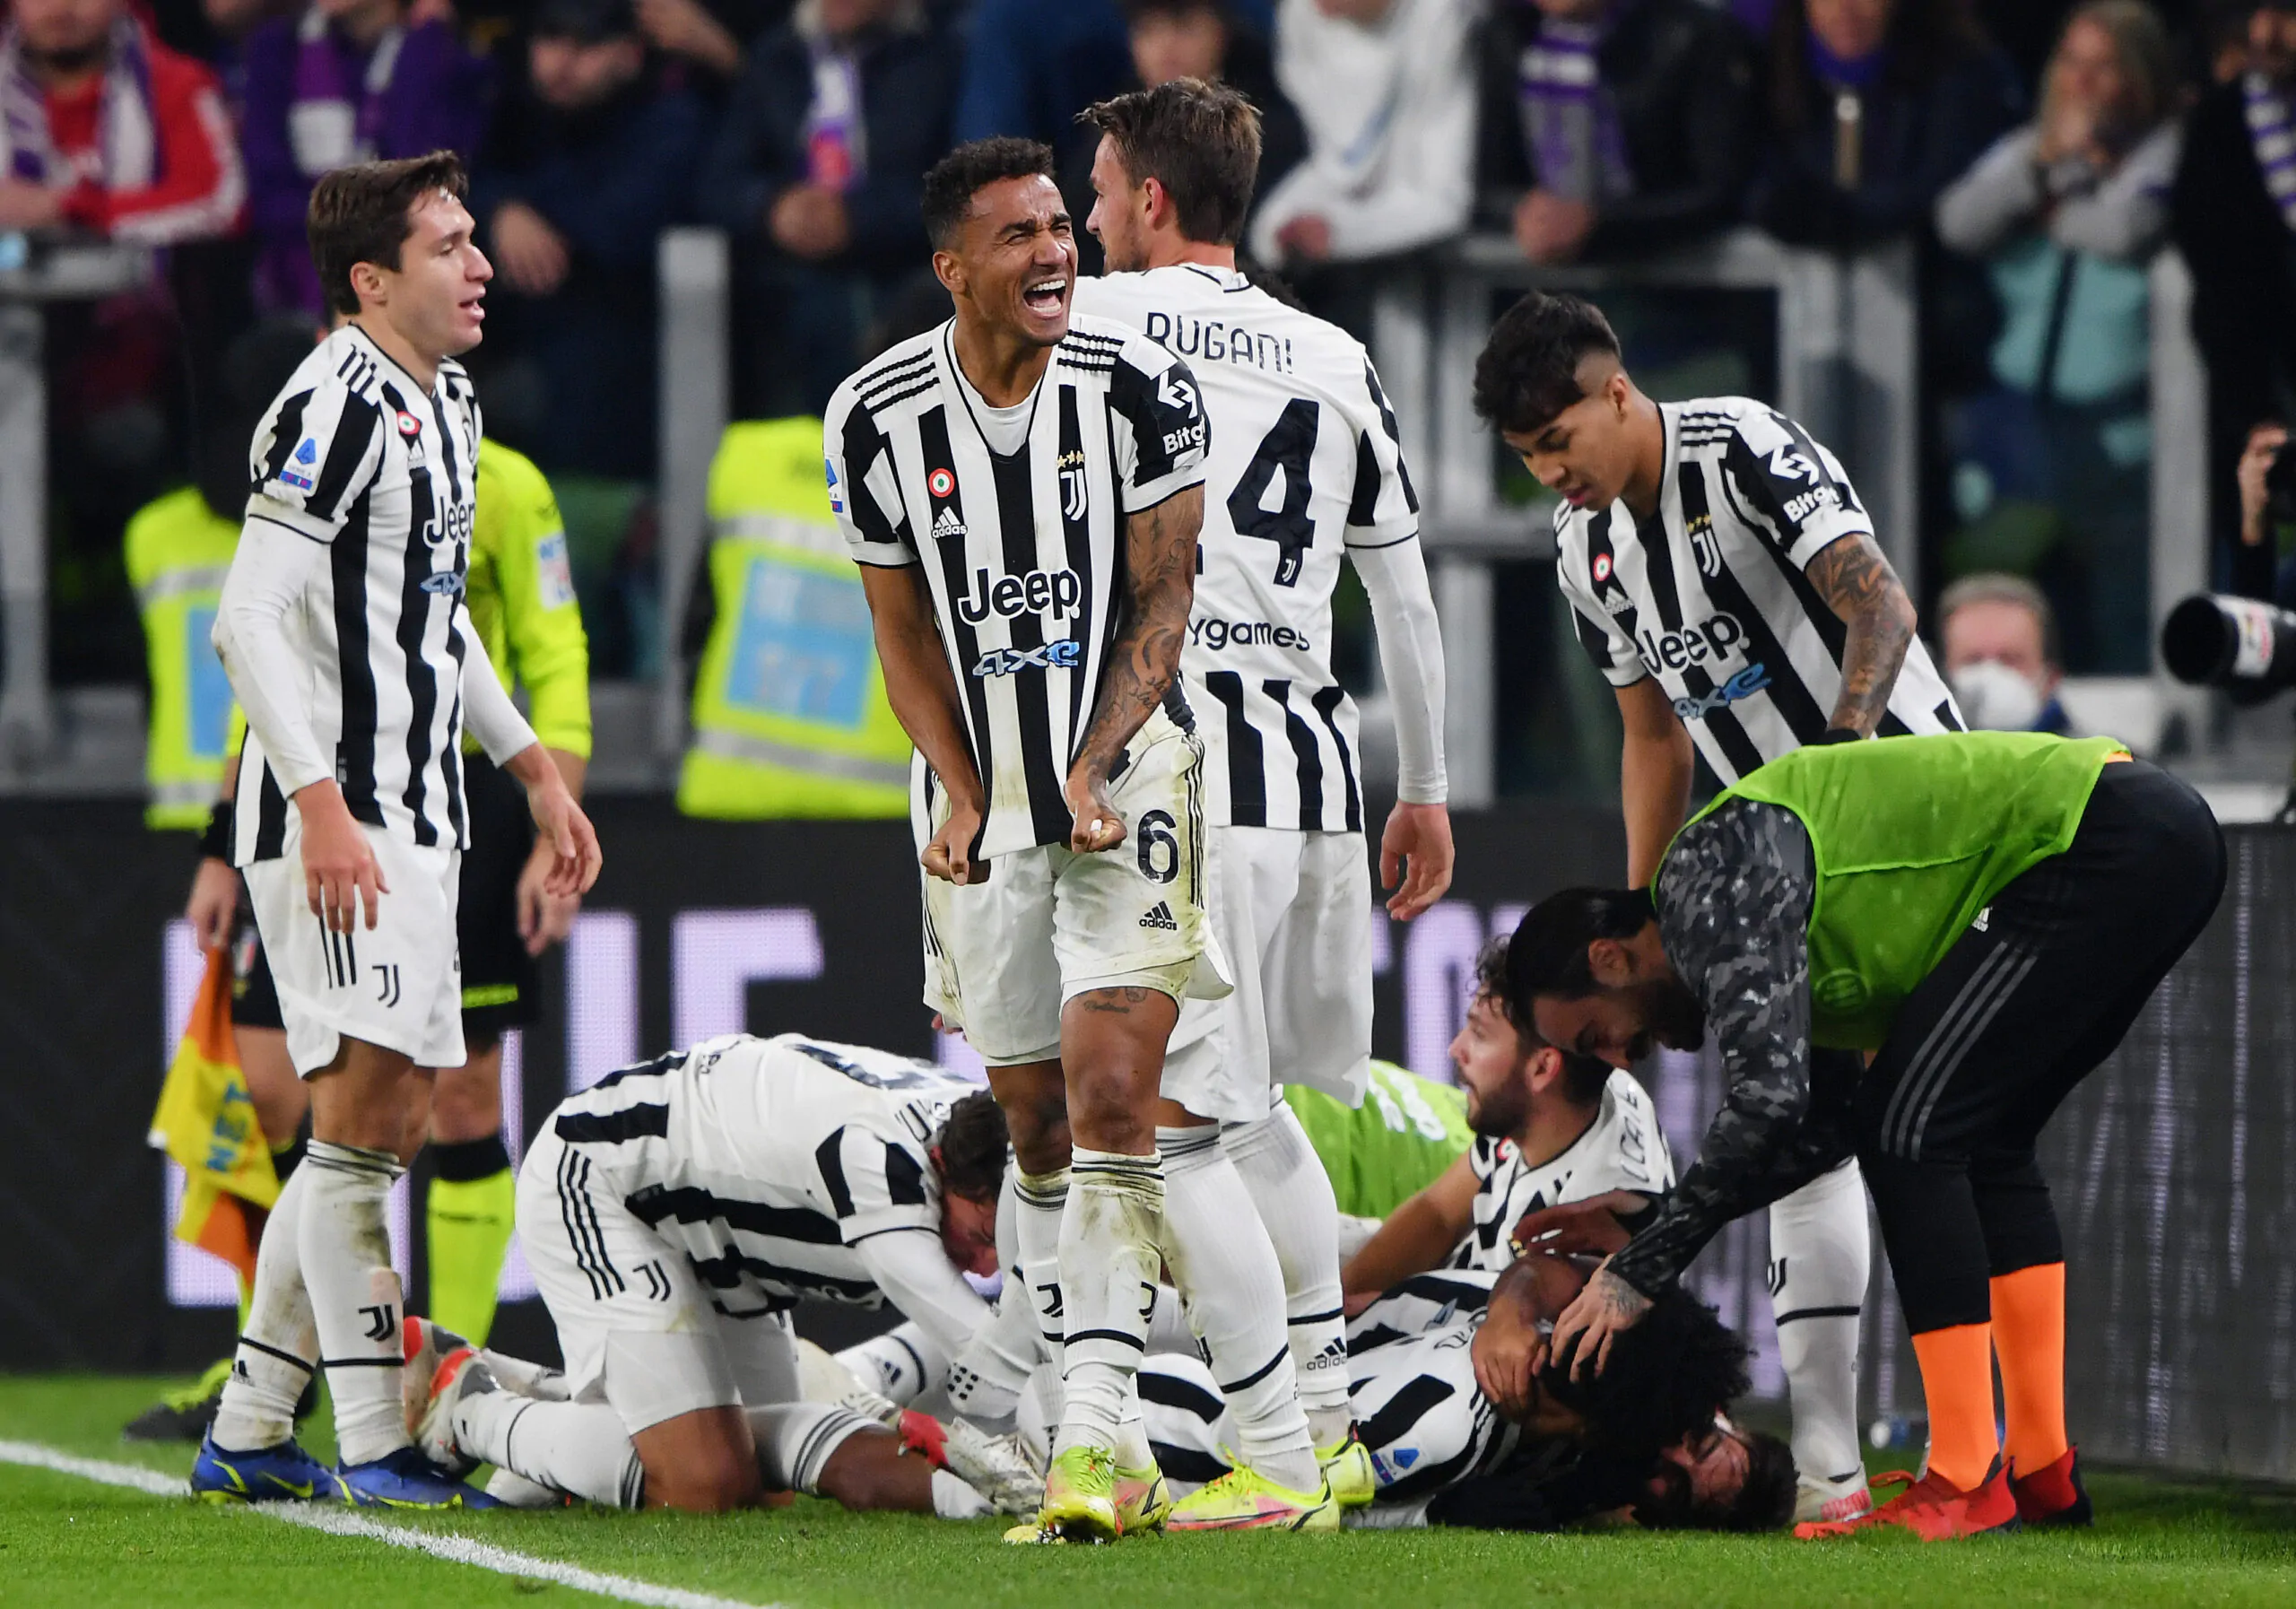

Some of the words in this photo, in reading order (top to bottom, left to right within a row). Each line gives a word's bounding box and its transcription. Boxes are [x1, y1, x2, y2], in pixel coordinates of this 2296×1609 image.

[1146, 311, 1293, 374] RUGANI
[1162, 413, 1206, 455] Bitg
[932, 525, 967, 538] adidas
[960, 568, 1079, 622] Jeep
[1187, 619, 1310, 651] ygames
[1642, 615, 1740, 674] Jeep
[1137, 809, 1179, 884] 6
[1139, 918, 1178, 931] adidas
